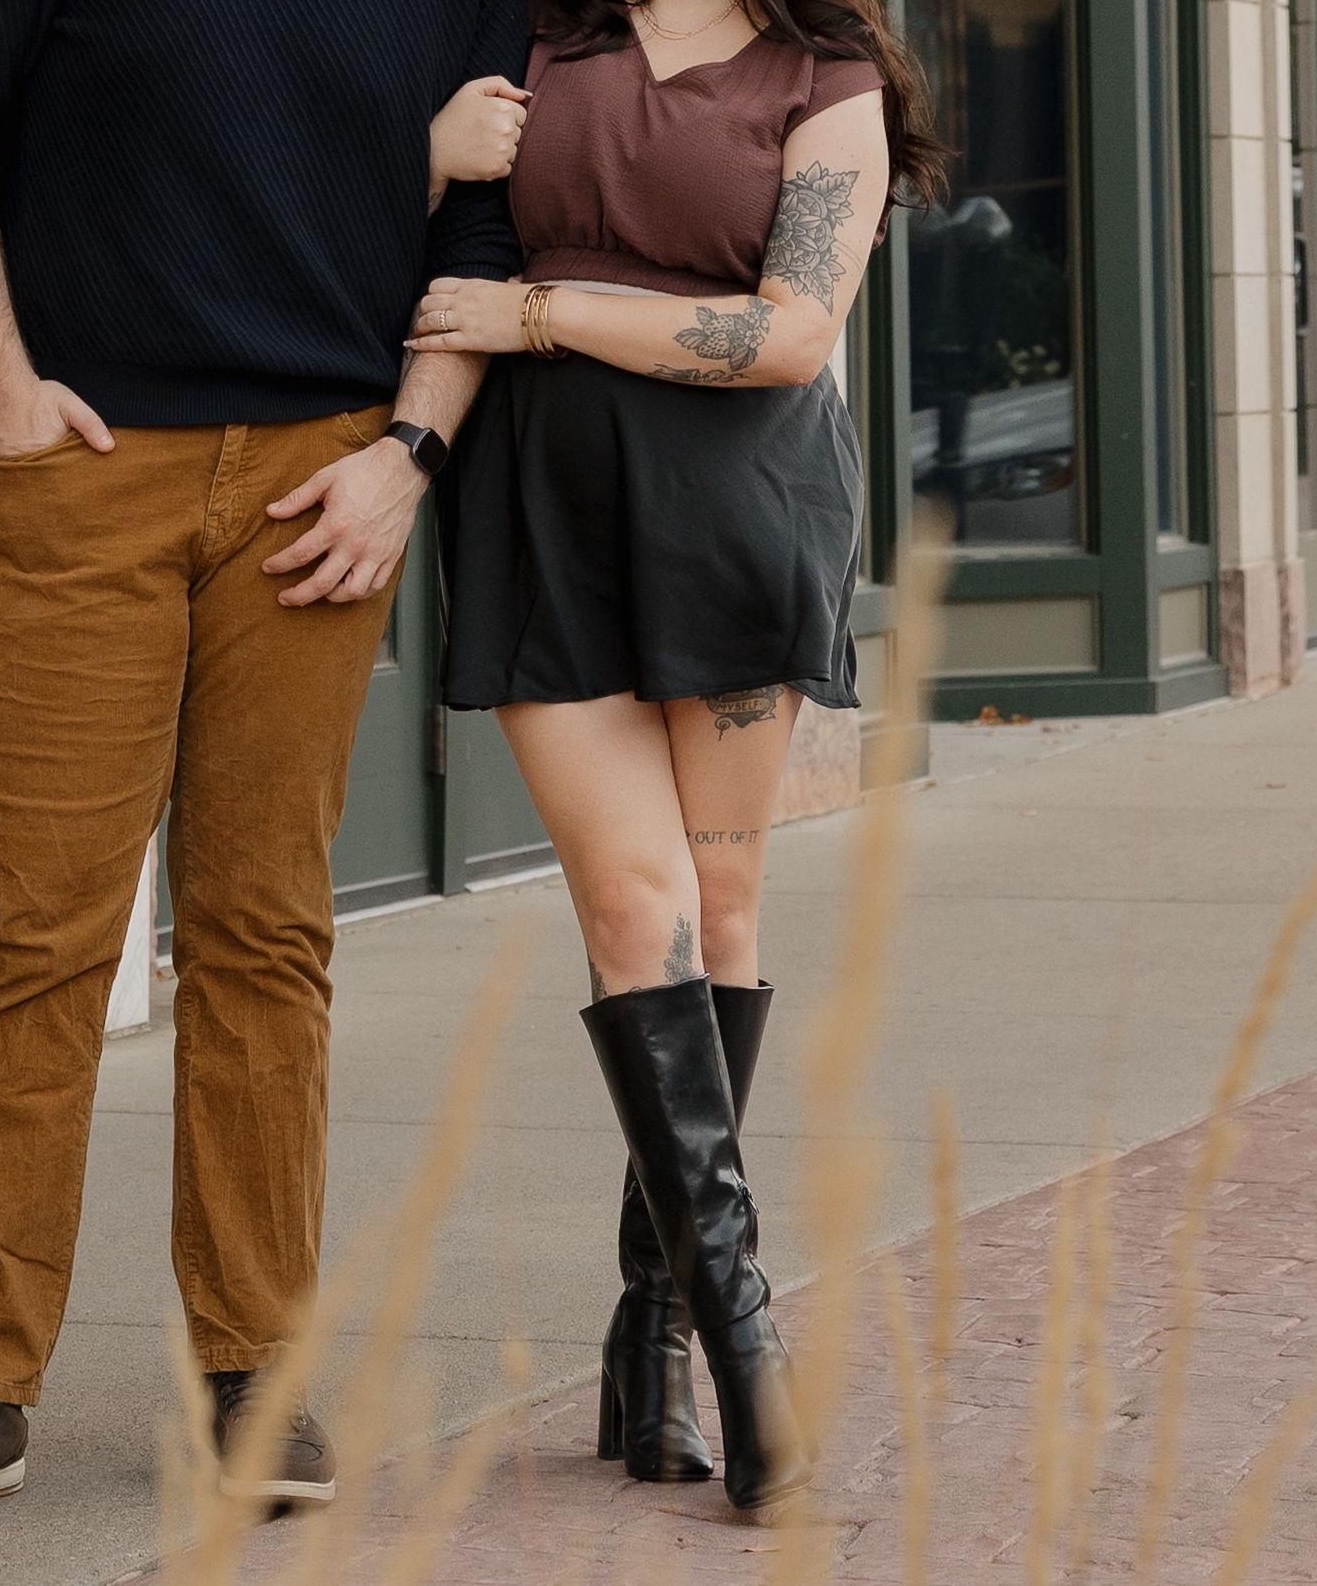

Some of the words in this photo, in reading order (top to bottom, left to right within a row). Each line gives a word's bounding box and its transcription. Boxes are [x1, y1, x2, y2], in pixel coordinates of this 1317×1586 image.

[715, 700, 760, 712] MYSELF
[694, 830, 726, 844] OUT
[729, 830, 746, 844] OF
[748, 830, 760, 843] IT
